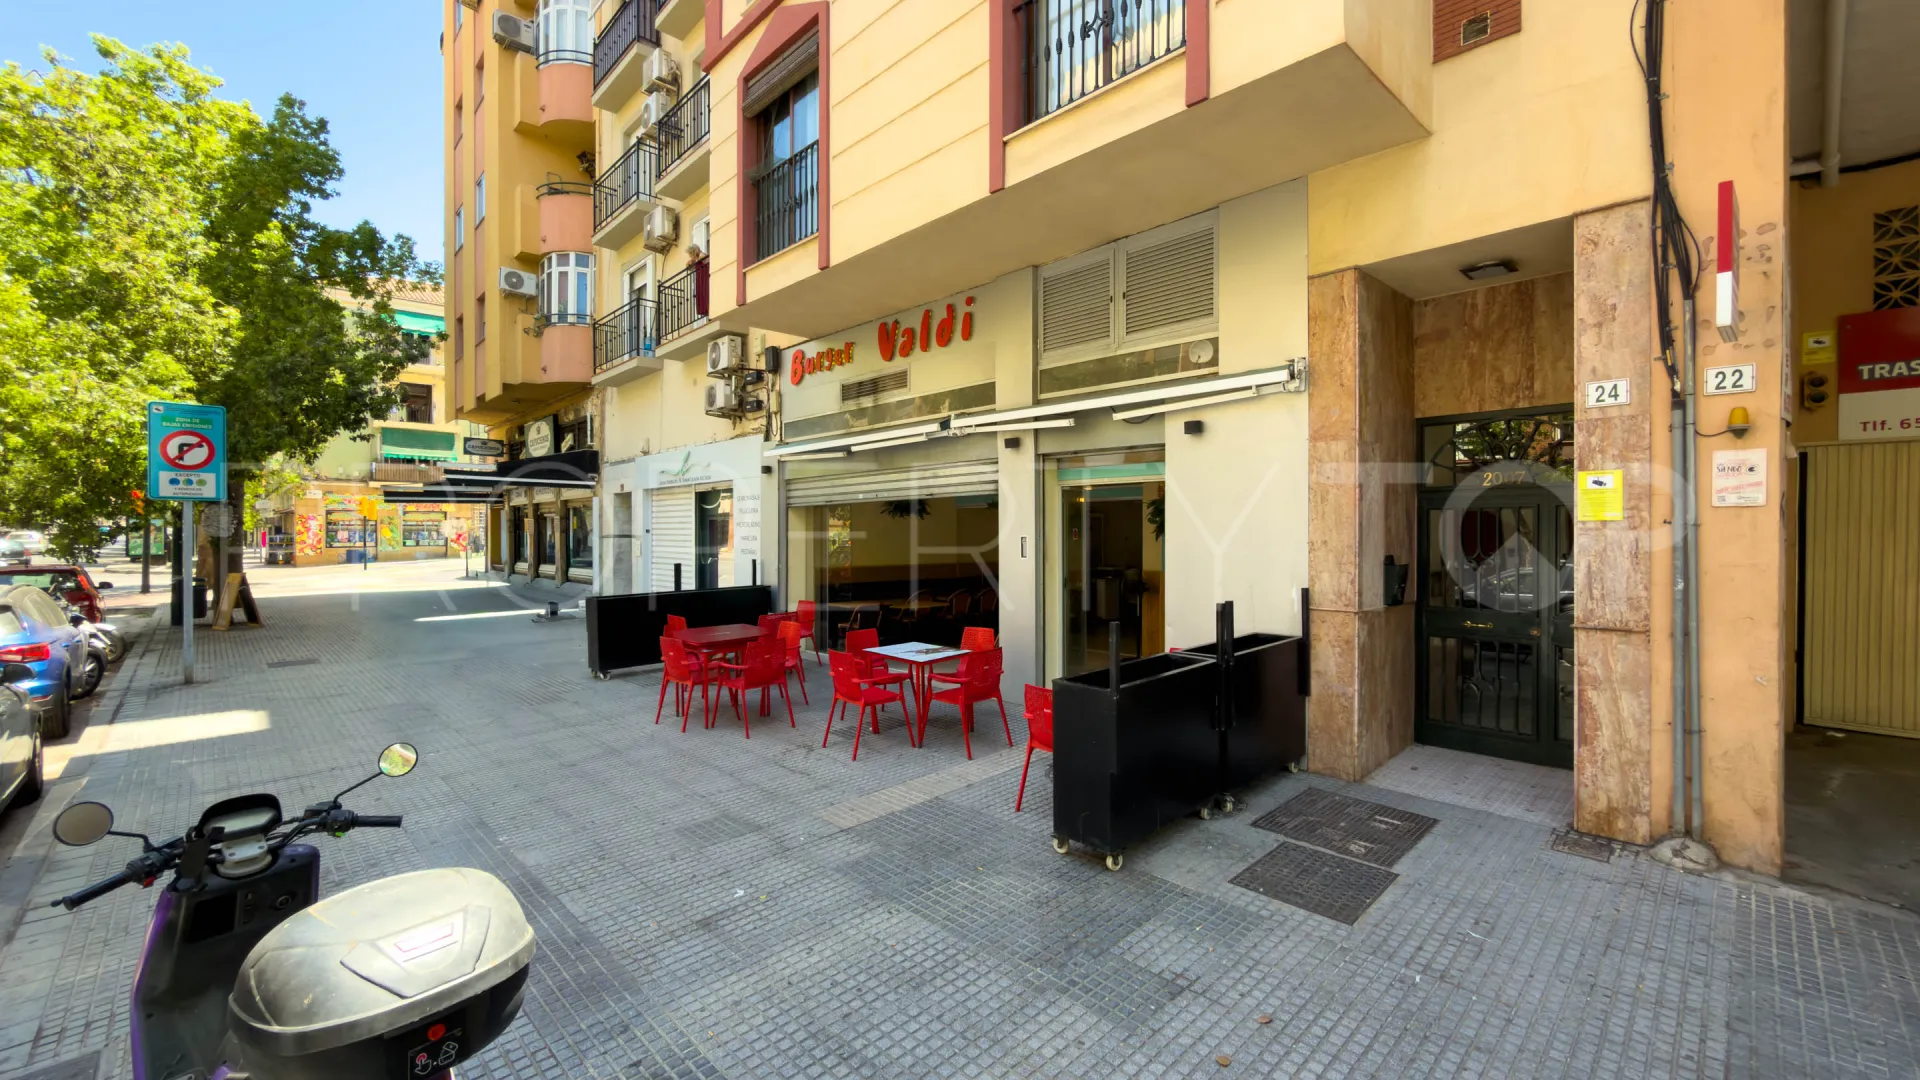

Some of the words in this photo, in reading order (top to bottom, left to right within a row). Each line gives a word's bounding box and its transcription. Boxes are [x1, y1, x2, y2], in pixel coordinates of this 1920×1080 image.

[790, 342, 855, 386] Burger
[877, 296, 975, 362] Valdi
[1714, 369, 1744, 390] 22
[1858, 360, 1920, 380] TRAS
[1595, 383, 1620, 403] 24
[1860, 420, 1892, 432] Tlf.
[1482, 471, 1526, 487] 2007
